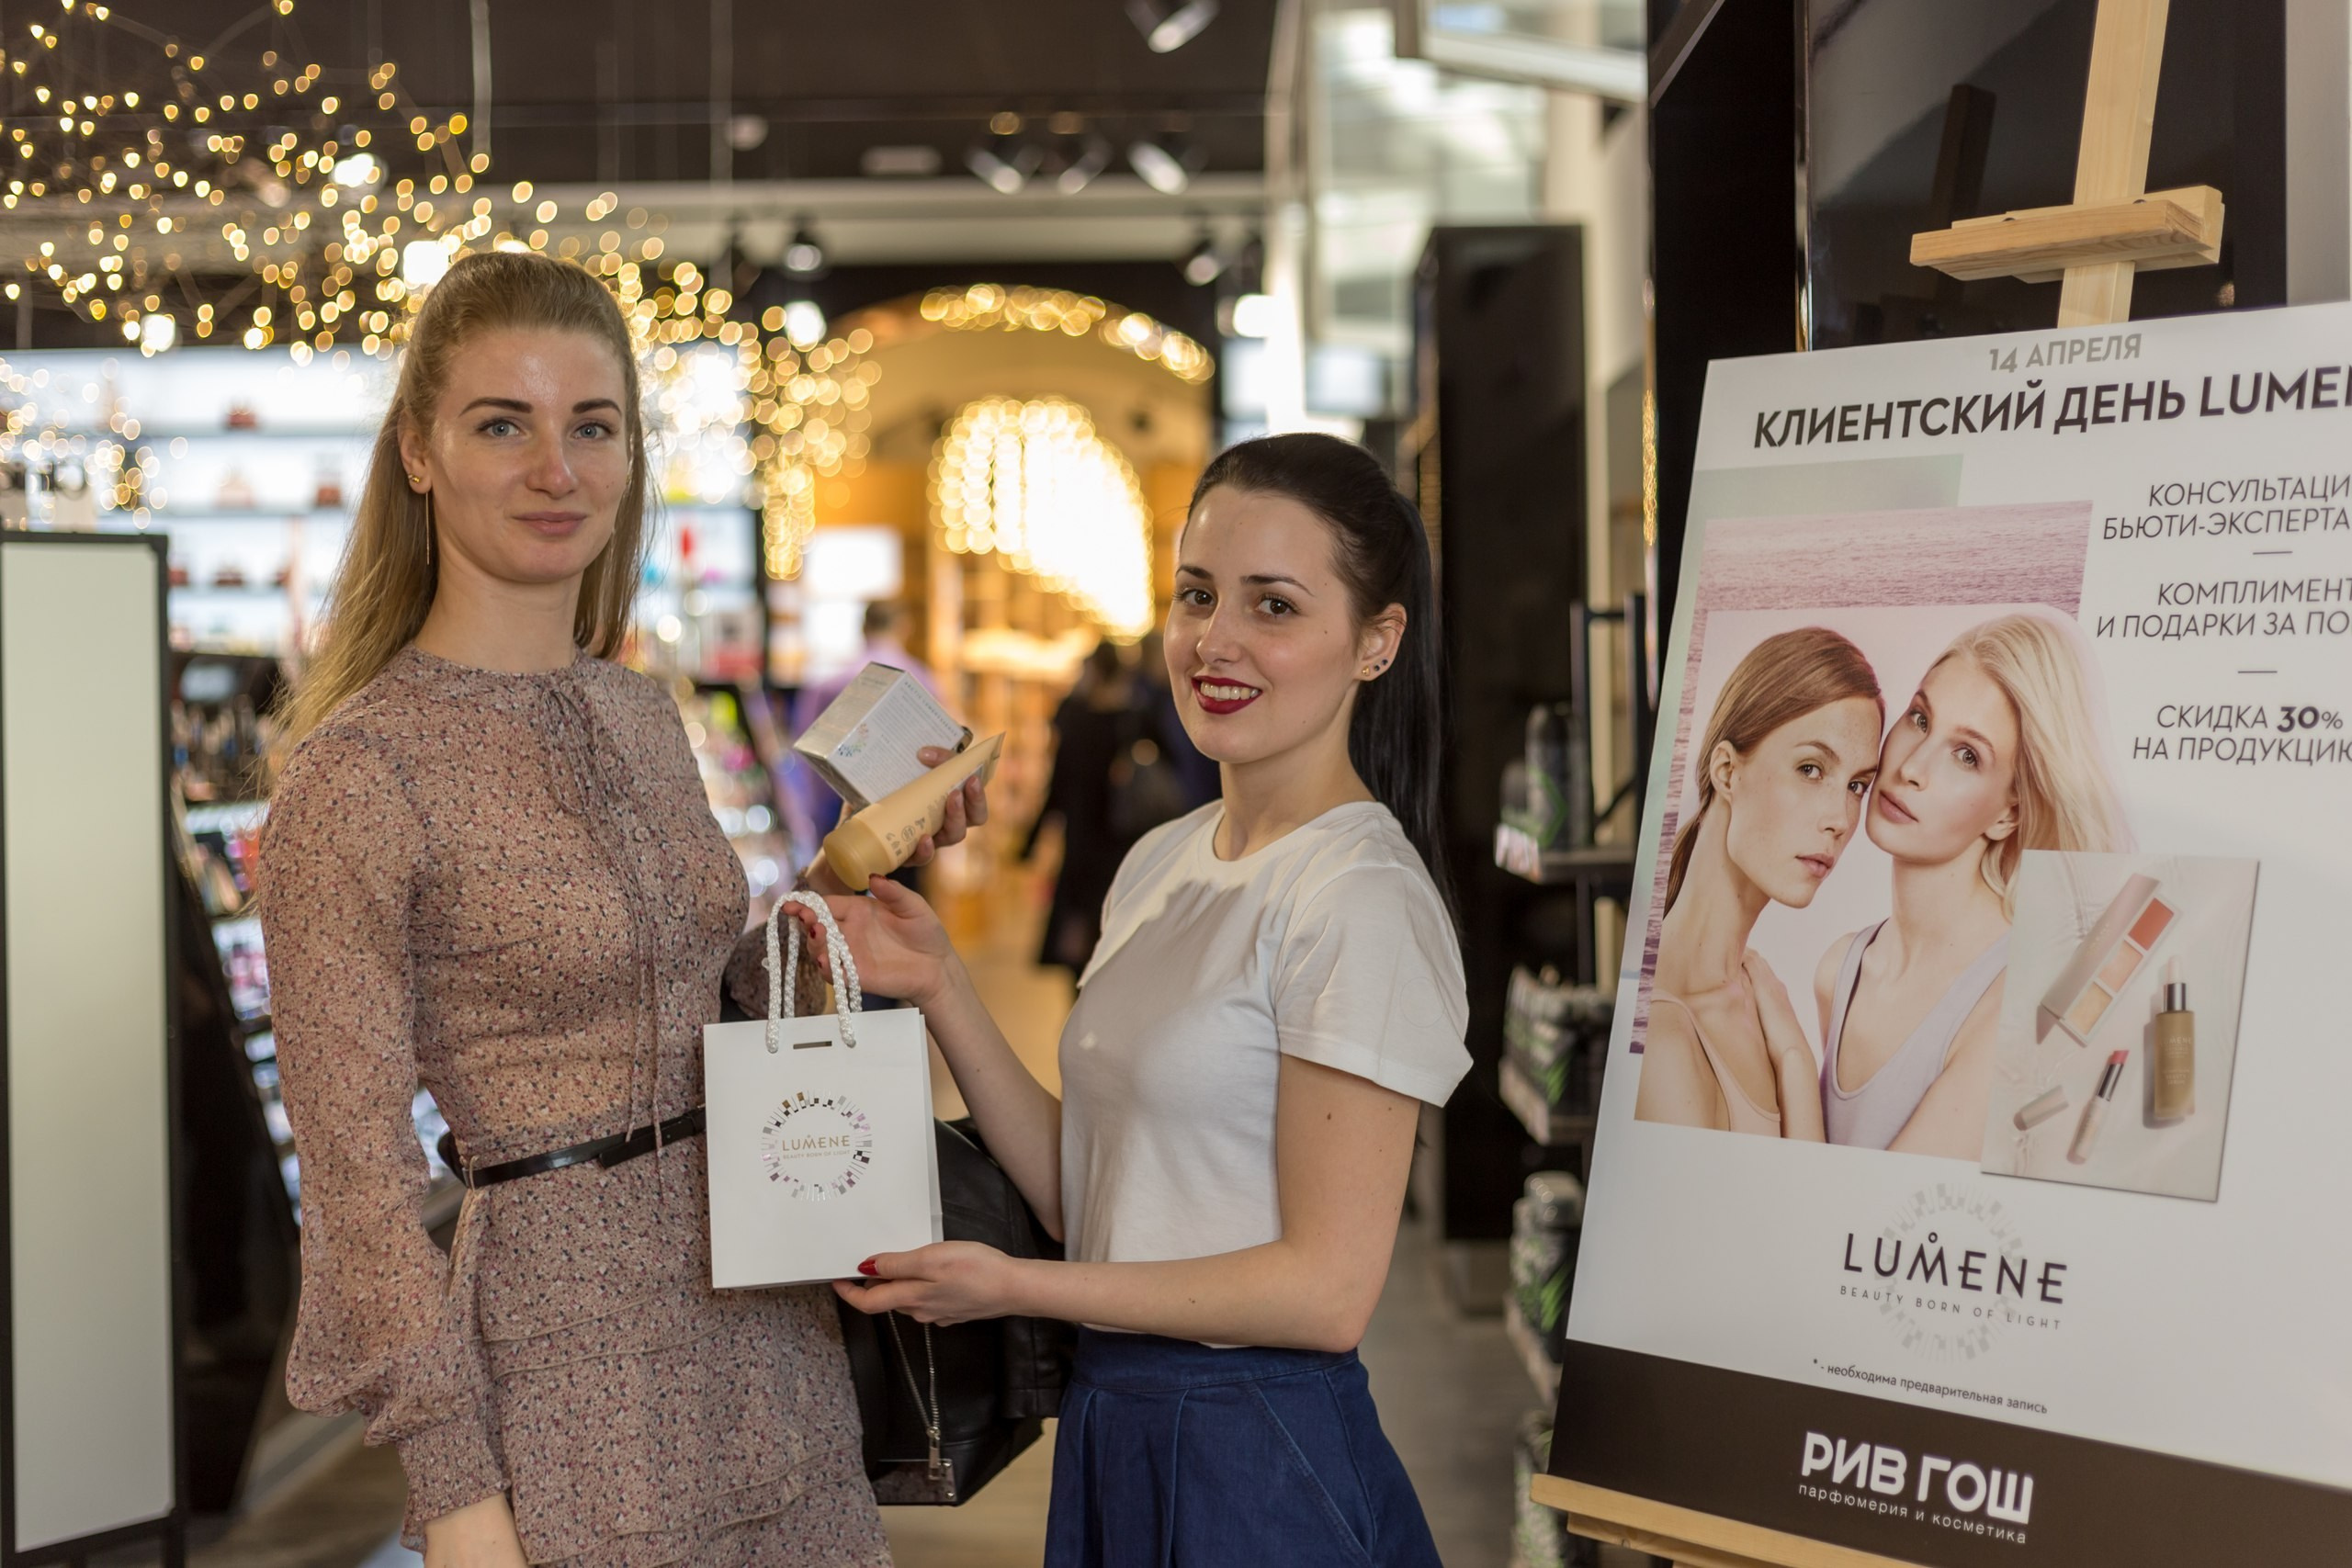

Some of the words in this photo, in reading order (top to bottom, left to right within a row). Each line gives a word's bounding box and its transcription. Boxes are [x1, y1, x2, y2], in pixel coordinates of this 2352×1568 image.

[1989, 347, 2018, 373] 14
[2025, 333, 2143, 367] АПРЕЛЯ
[1753, 378, 2047, 448] КЛИЕНТСКИЙ
[2052, 378, 2186, 435] ДЕНЬ
[2199, 364, 2352, 417] LUME
[2148, 474, 2352, 507] КОНСУЛЬТАЦИ
[2103, 506, 2351, 540] БЬЮТИ-ЭКСПЕРТА
[2097, 615, 2115, 637] И
[2122, 613, 2256, 641] ПОДАРКИ
[2263, 612, 2297, 636] ЗА
[2156, 705, 2268, 733] СКИДКА
[2277, 705, 2344, 733] 30%
[2132, 737, 2169, 761] НА
[782, 1134, 851, 1151] LUMENE
[1843, 1231, 2067, 1305] LUMENE
[1839, 1285, 1904, 1304] BEAUTY
[1916, 1297, 1962, 1314] BORN
[1973, 1307, 1995, 1320] OF
[2006, 1312, 2061, 1331] LIGHT
[1826, 1364, 1897, 1386] необходима
[1899, 1378, 2003, 1406] предварительная
[2006, 1398, 2048, 1415] запись
[1801, 1430, 1908, 1495] РИВ
[1917, 1454, 2035, 1526] ГОШ
[1798, 1483, 1908, 1517] парфюмерия
[1915, 1510, 1925, 1521] и
[1931, 1514, 2027, 1544] косметика
